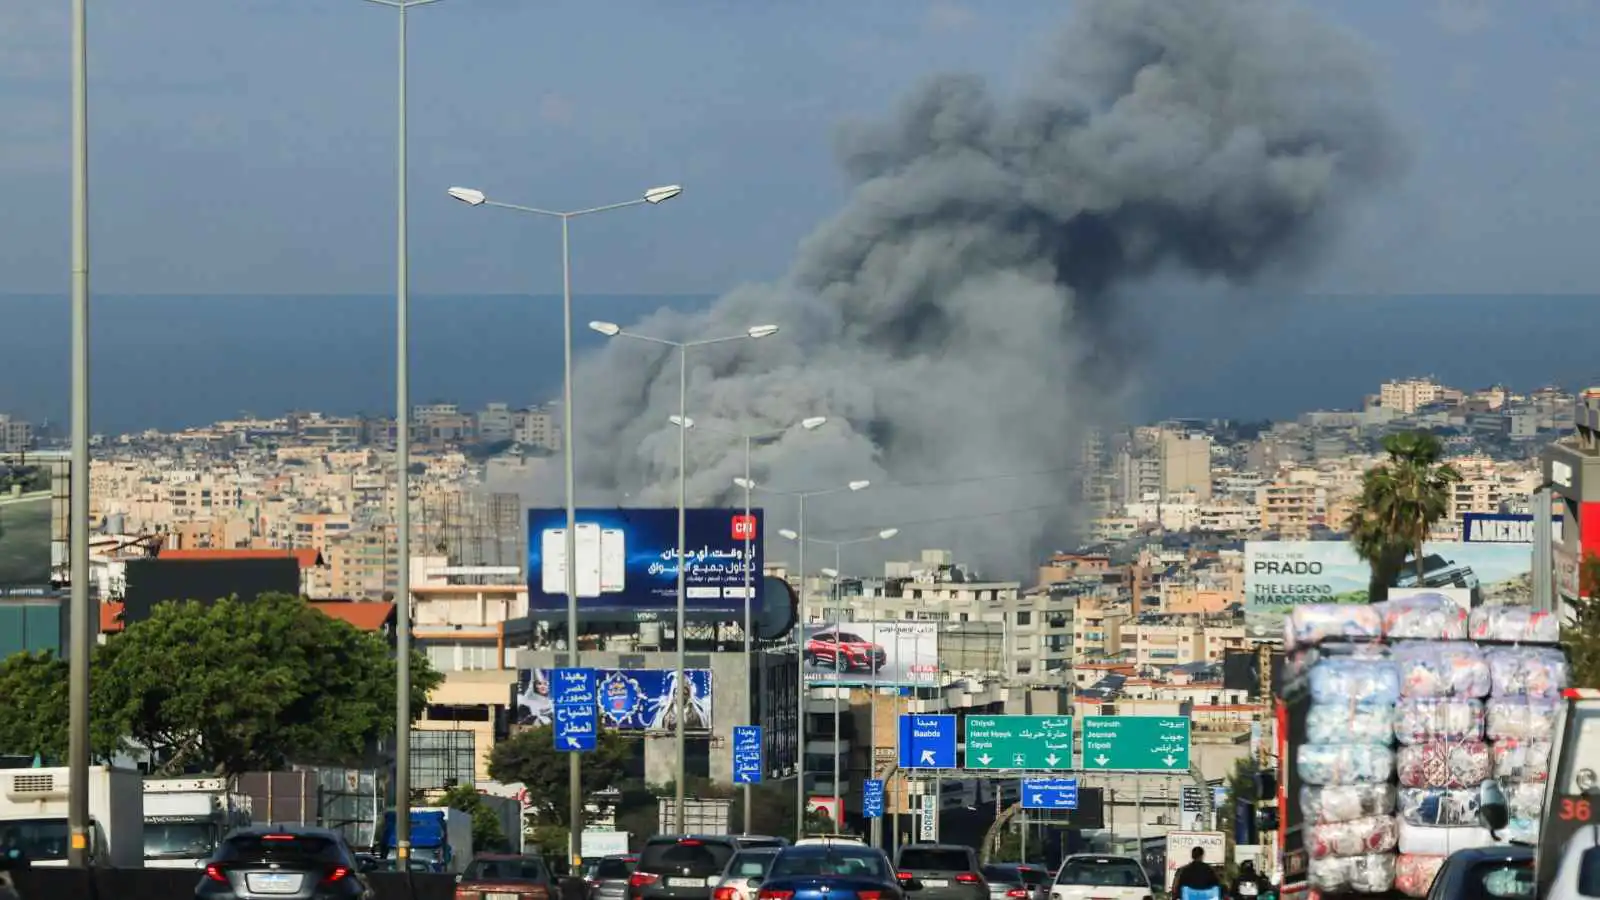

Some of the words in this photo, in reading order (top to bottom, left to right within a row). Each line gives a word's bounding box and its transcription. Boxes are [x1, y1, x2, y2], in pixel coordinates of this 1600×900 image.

[692, 563, 724, 577] جميع
[1254, 561, 1323, 575] PRADO
[1254, 584, 1278, 594] THE
[1281, 584, 1332, 594] LEGEND
[1254, 595, 1316, 605] MARCHES
[560, 721, 592, 737] المطار
[1559, 798, 1591, 821] 36
